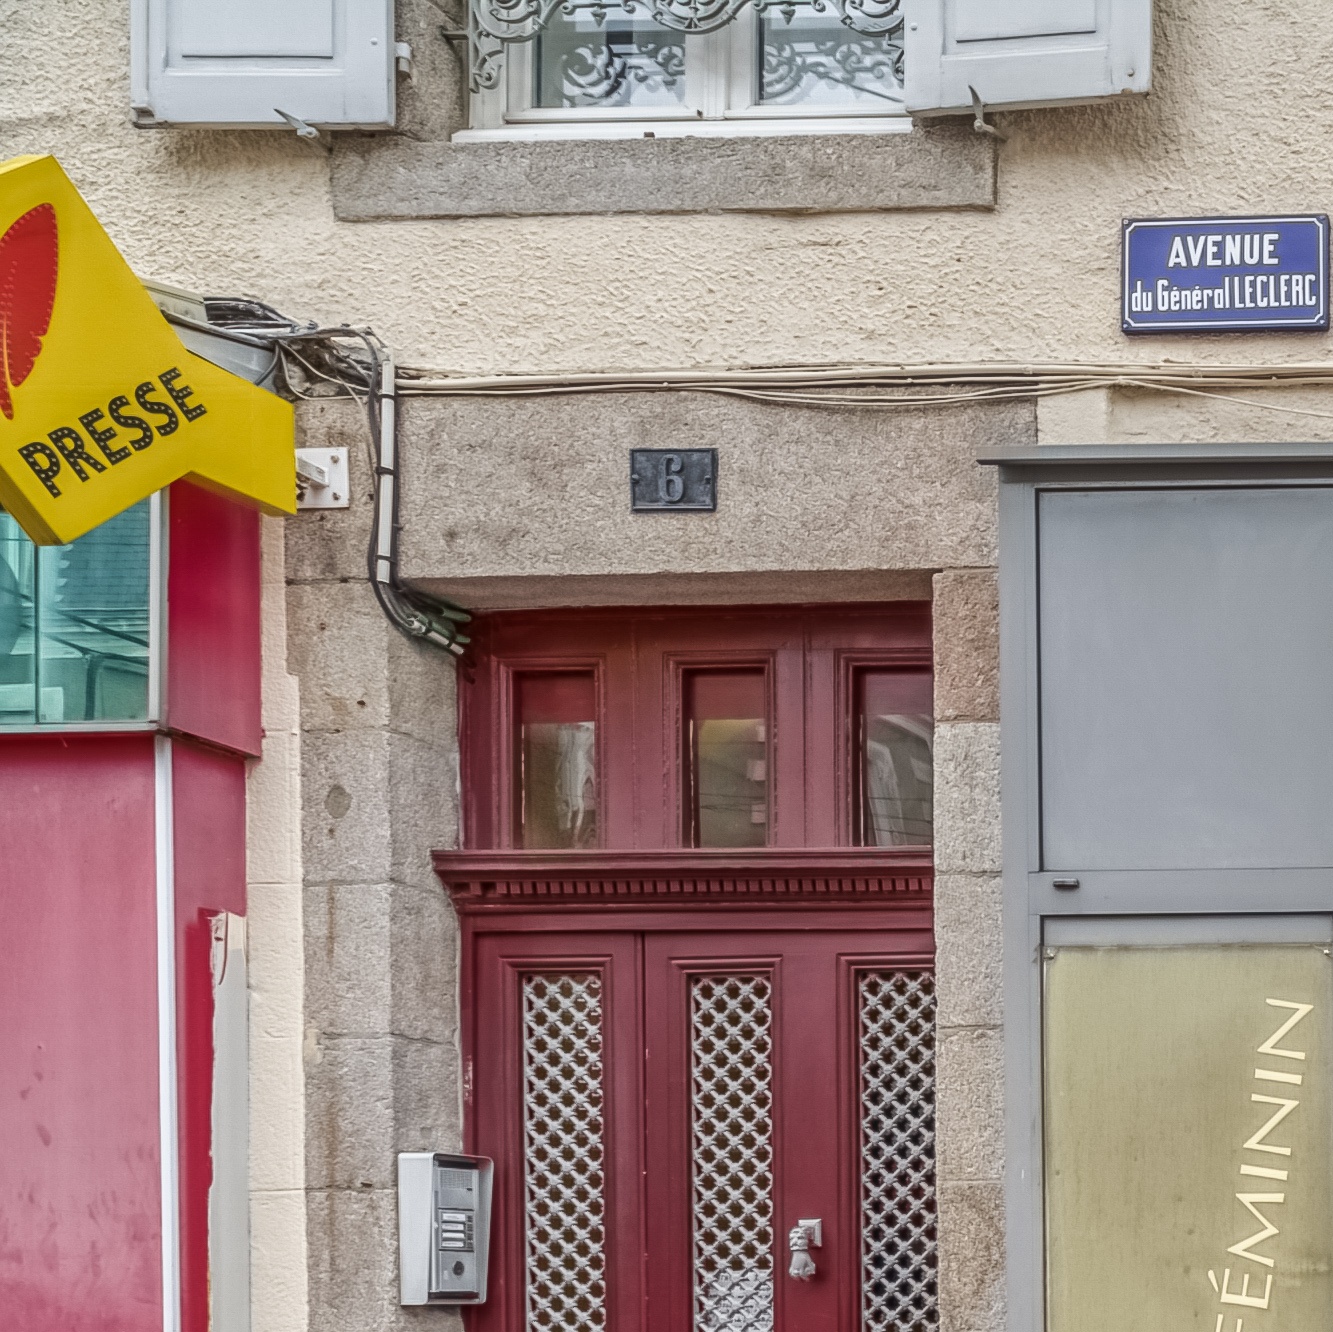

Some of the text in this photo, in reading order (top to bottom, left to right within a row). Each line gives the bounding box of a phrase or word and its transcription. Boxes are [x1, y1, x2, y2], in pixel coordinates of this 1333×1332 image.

[1167, 233, 1279, 268] AVENUE
[1131, 274, 1316, 312] du Général LECLERC
[17, 367, 206, 499] PRESSE
[657, 453, 684, 503] 6
